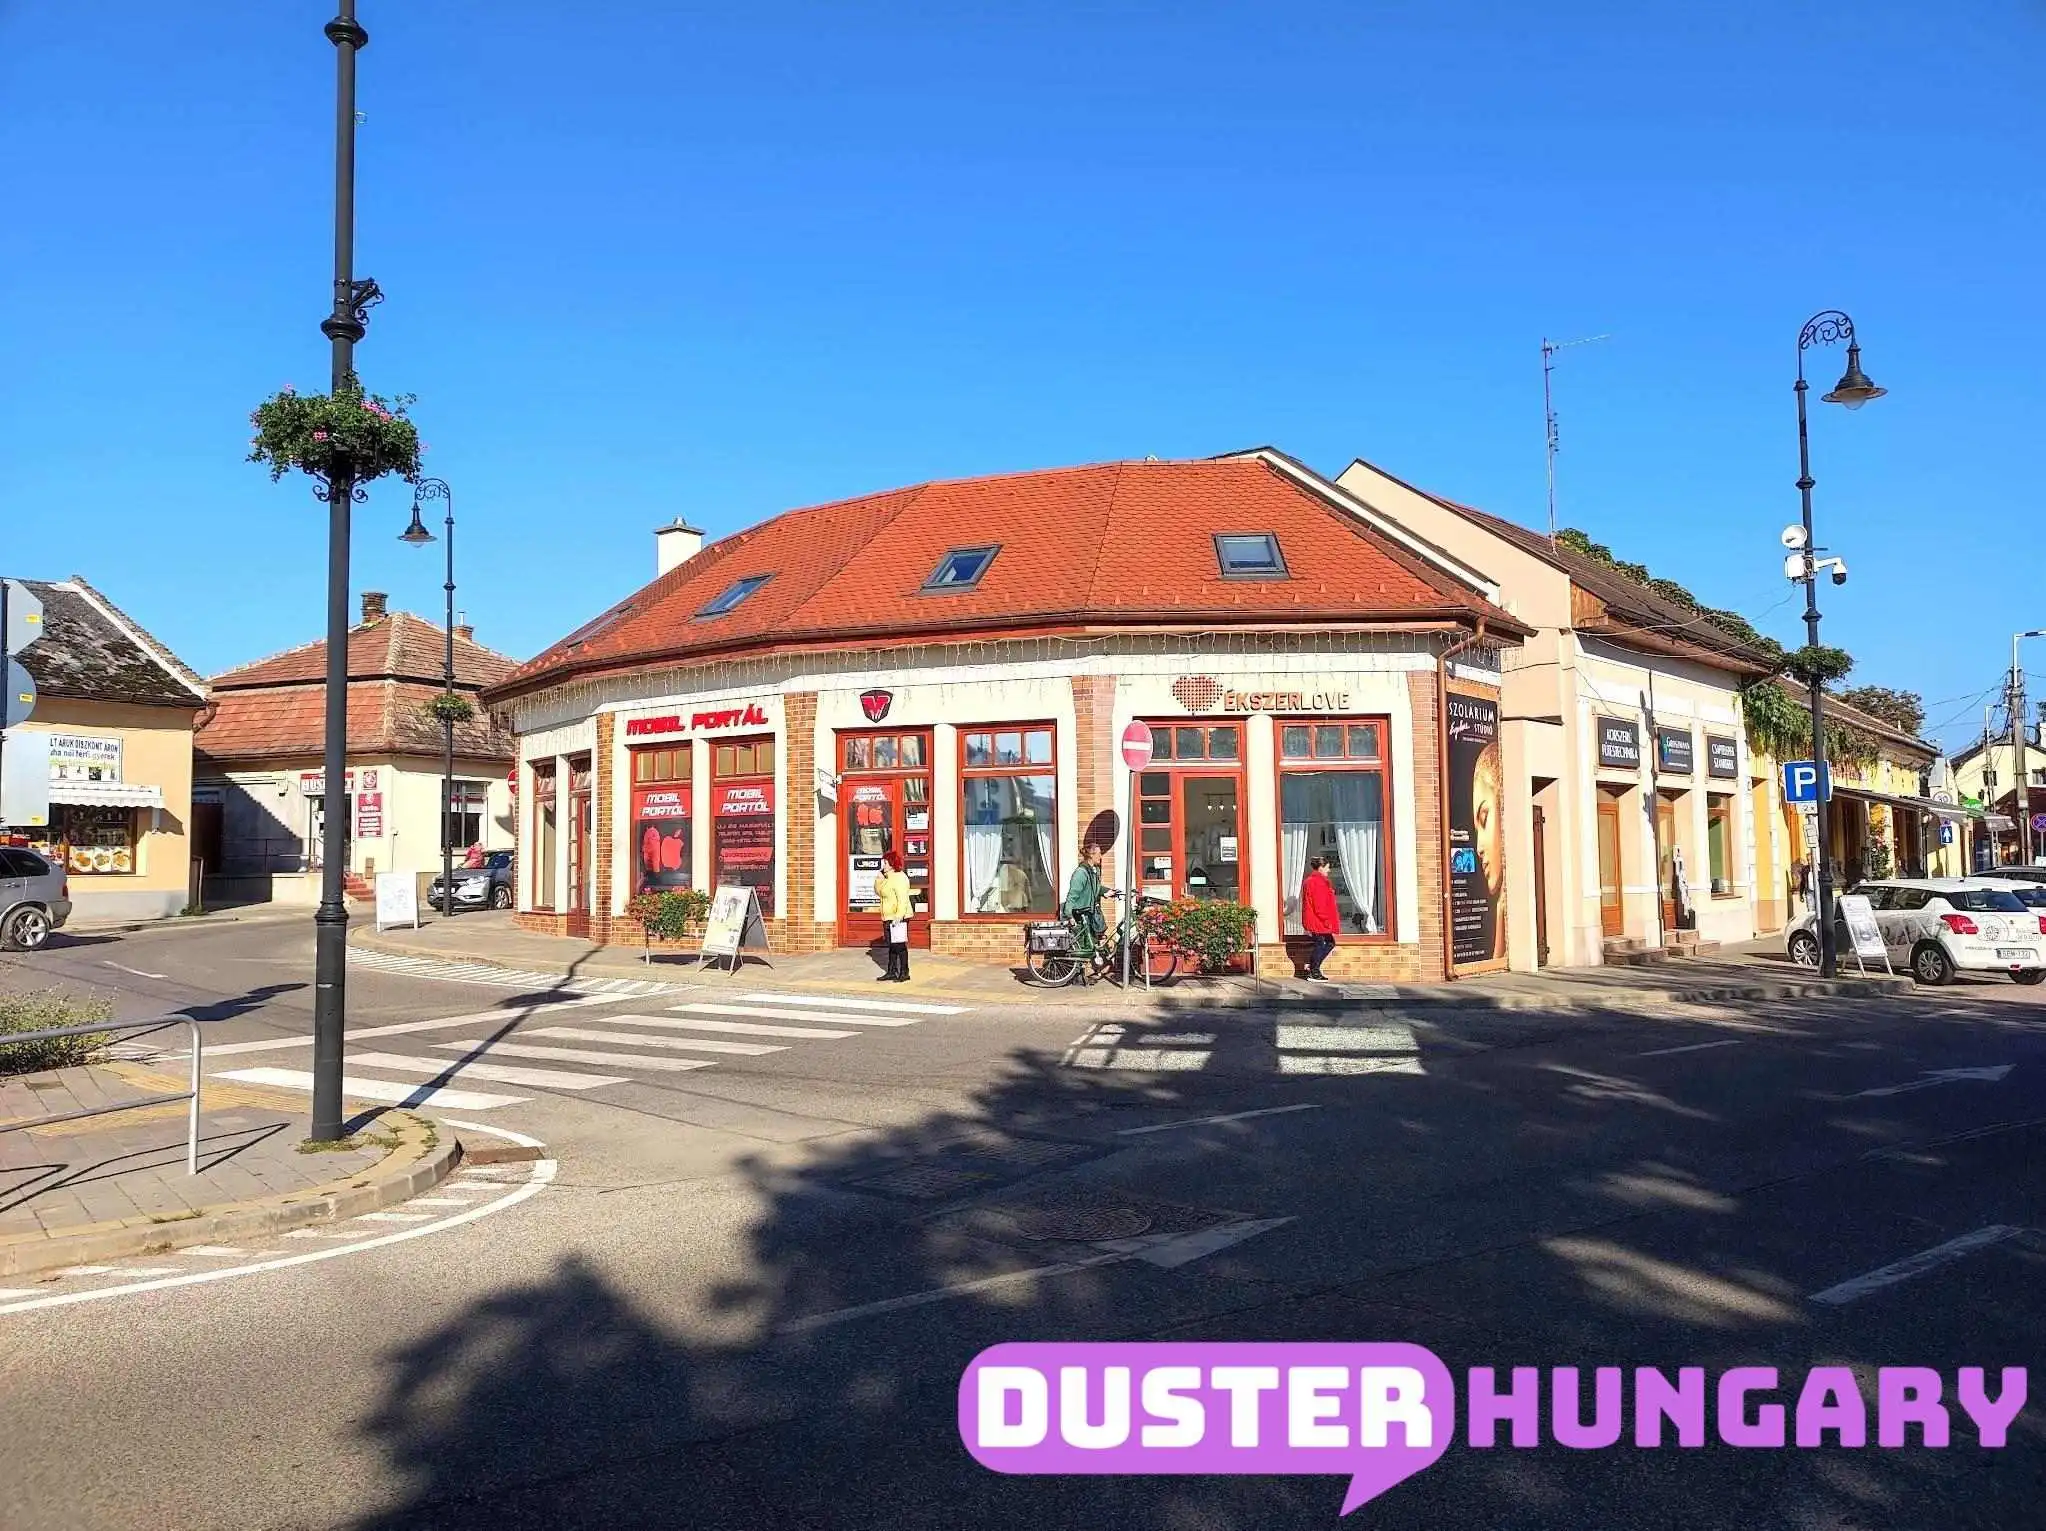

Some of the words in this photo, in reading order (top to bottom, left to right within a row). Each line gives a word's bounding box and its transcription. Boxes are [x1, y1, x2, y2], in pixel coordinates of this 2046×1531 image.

[1224, 689, 1351, 712] ÉKSZERLOVE
[626, 715, 686, 736] MOBIL
[691, 703, 769, 731] PORTÁL
[1448, 701, 1495, 723] SZOLÁRIUM
[727, 787, 765, 800] MOBIL
[1793, 767, 1817, 798] P
[646, 792, 681, 804] MOBIL
